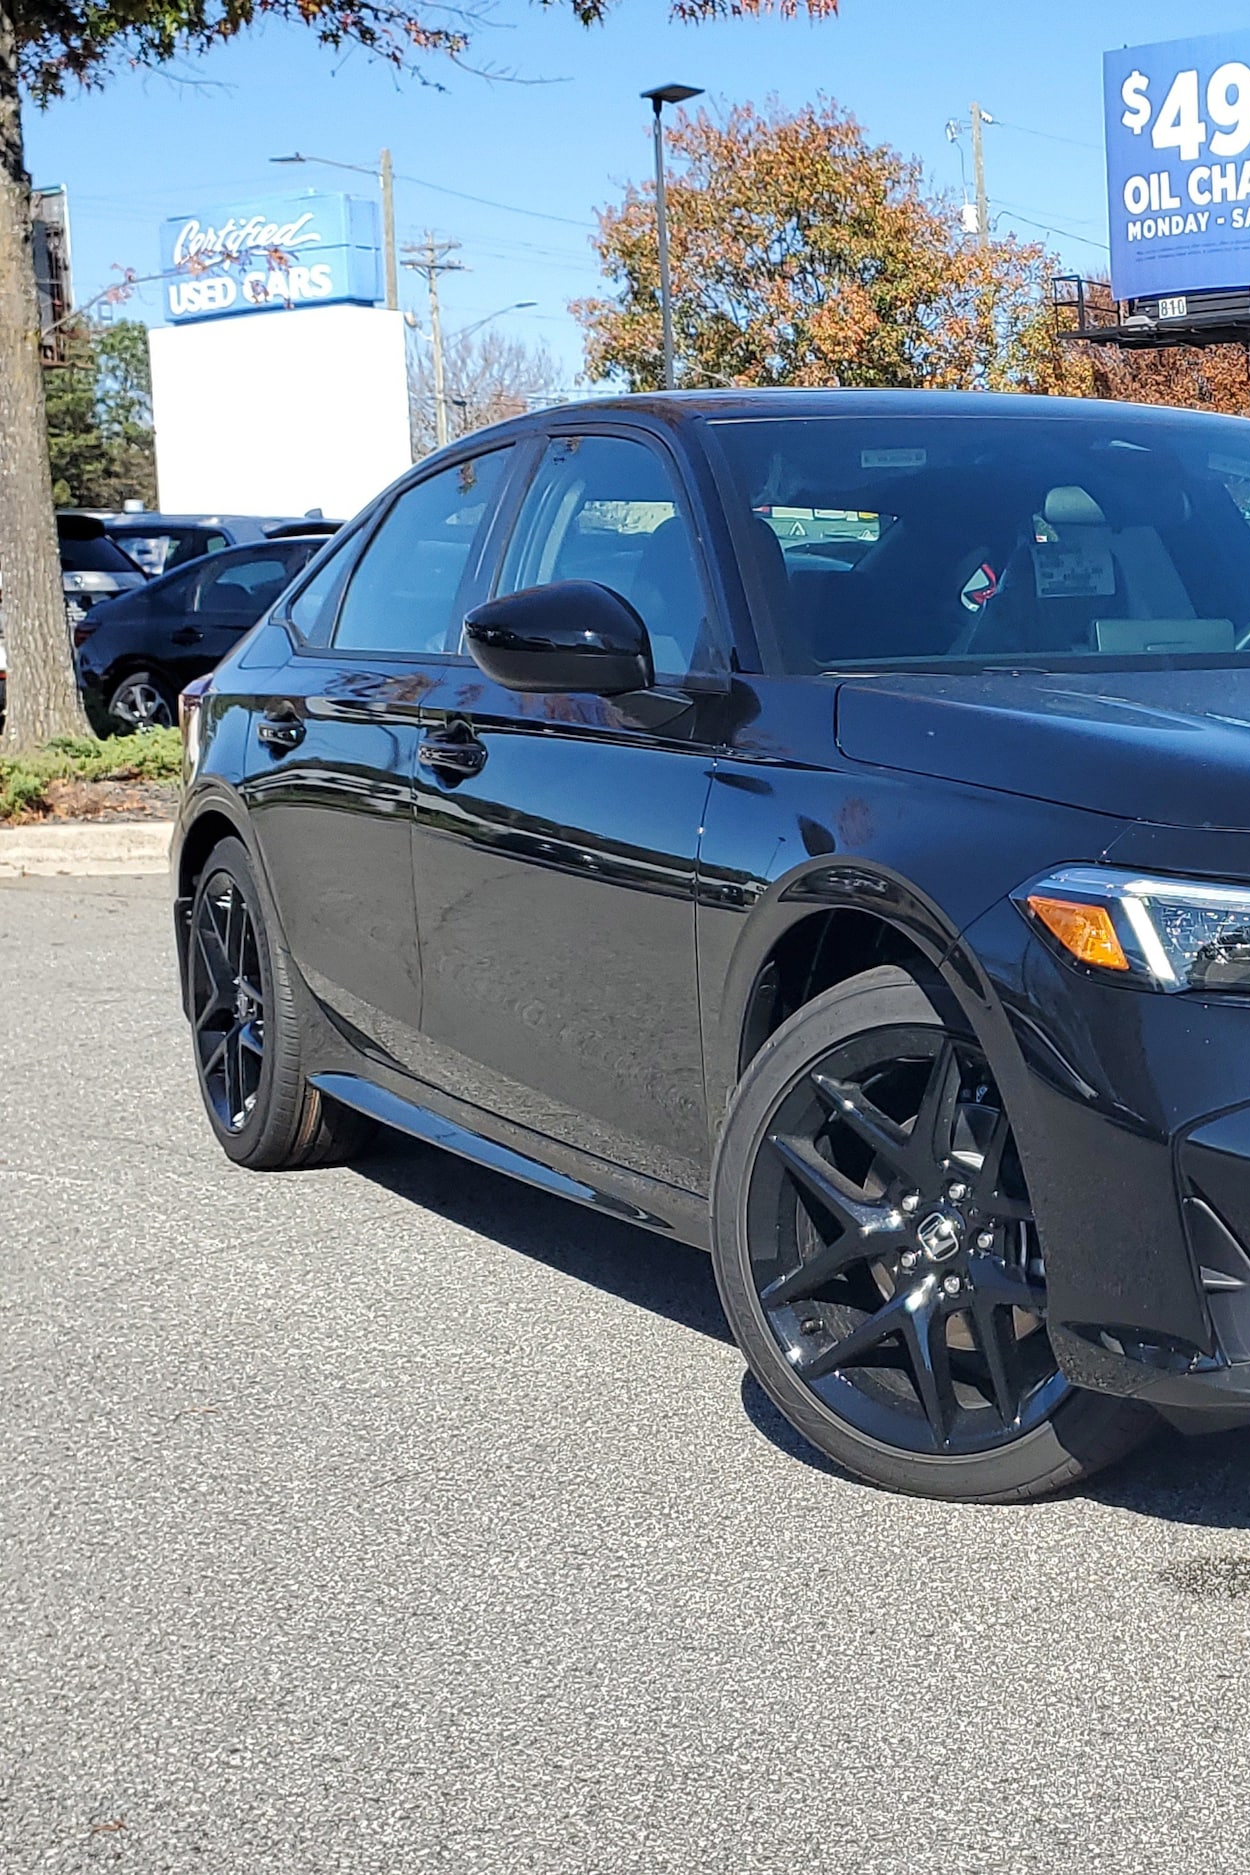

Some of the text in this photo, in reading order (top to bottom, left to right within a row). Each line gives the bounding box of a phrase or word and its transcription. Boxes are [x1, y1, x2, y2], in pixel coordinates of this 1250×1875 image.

[1123, 171, 1181, 215] OIL
[173, 212, 322, 270] Certified
[1127, 211, 1209, 241] MONDAY
[168, 263, 333, 315] USED CARS
[1160, 298, 1185, 317] 810
